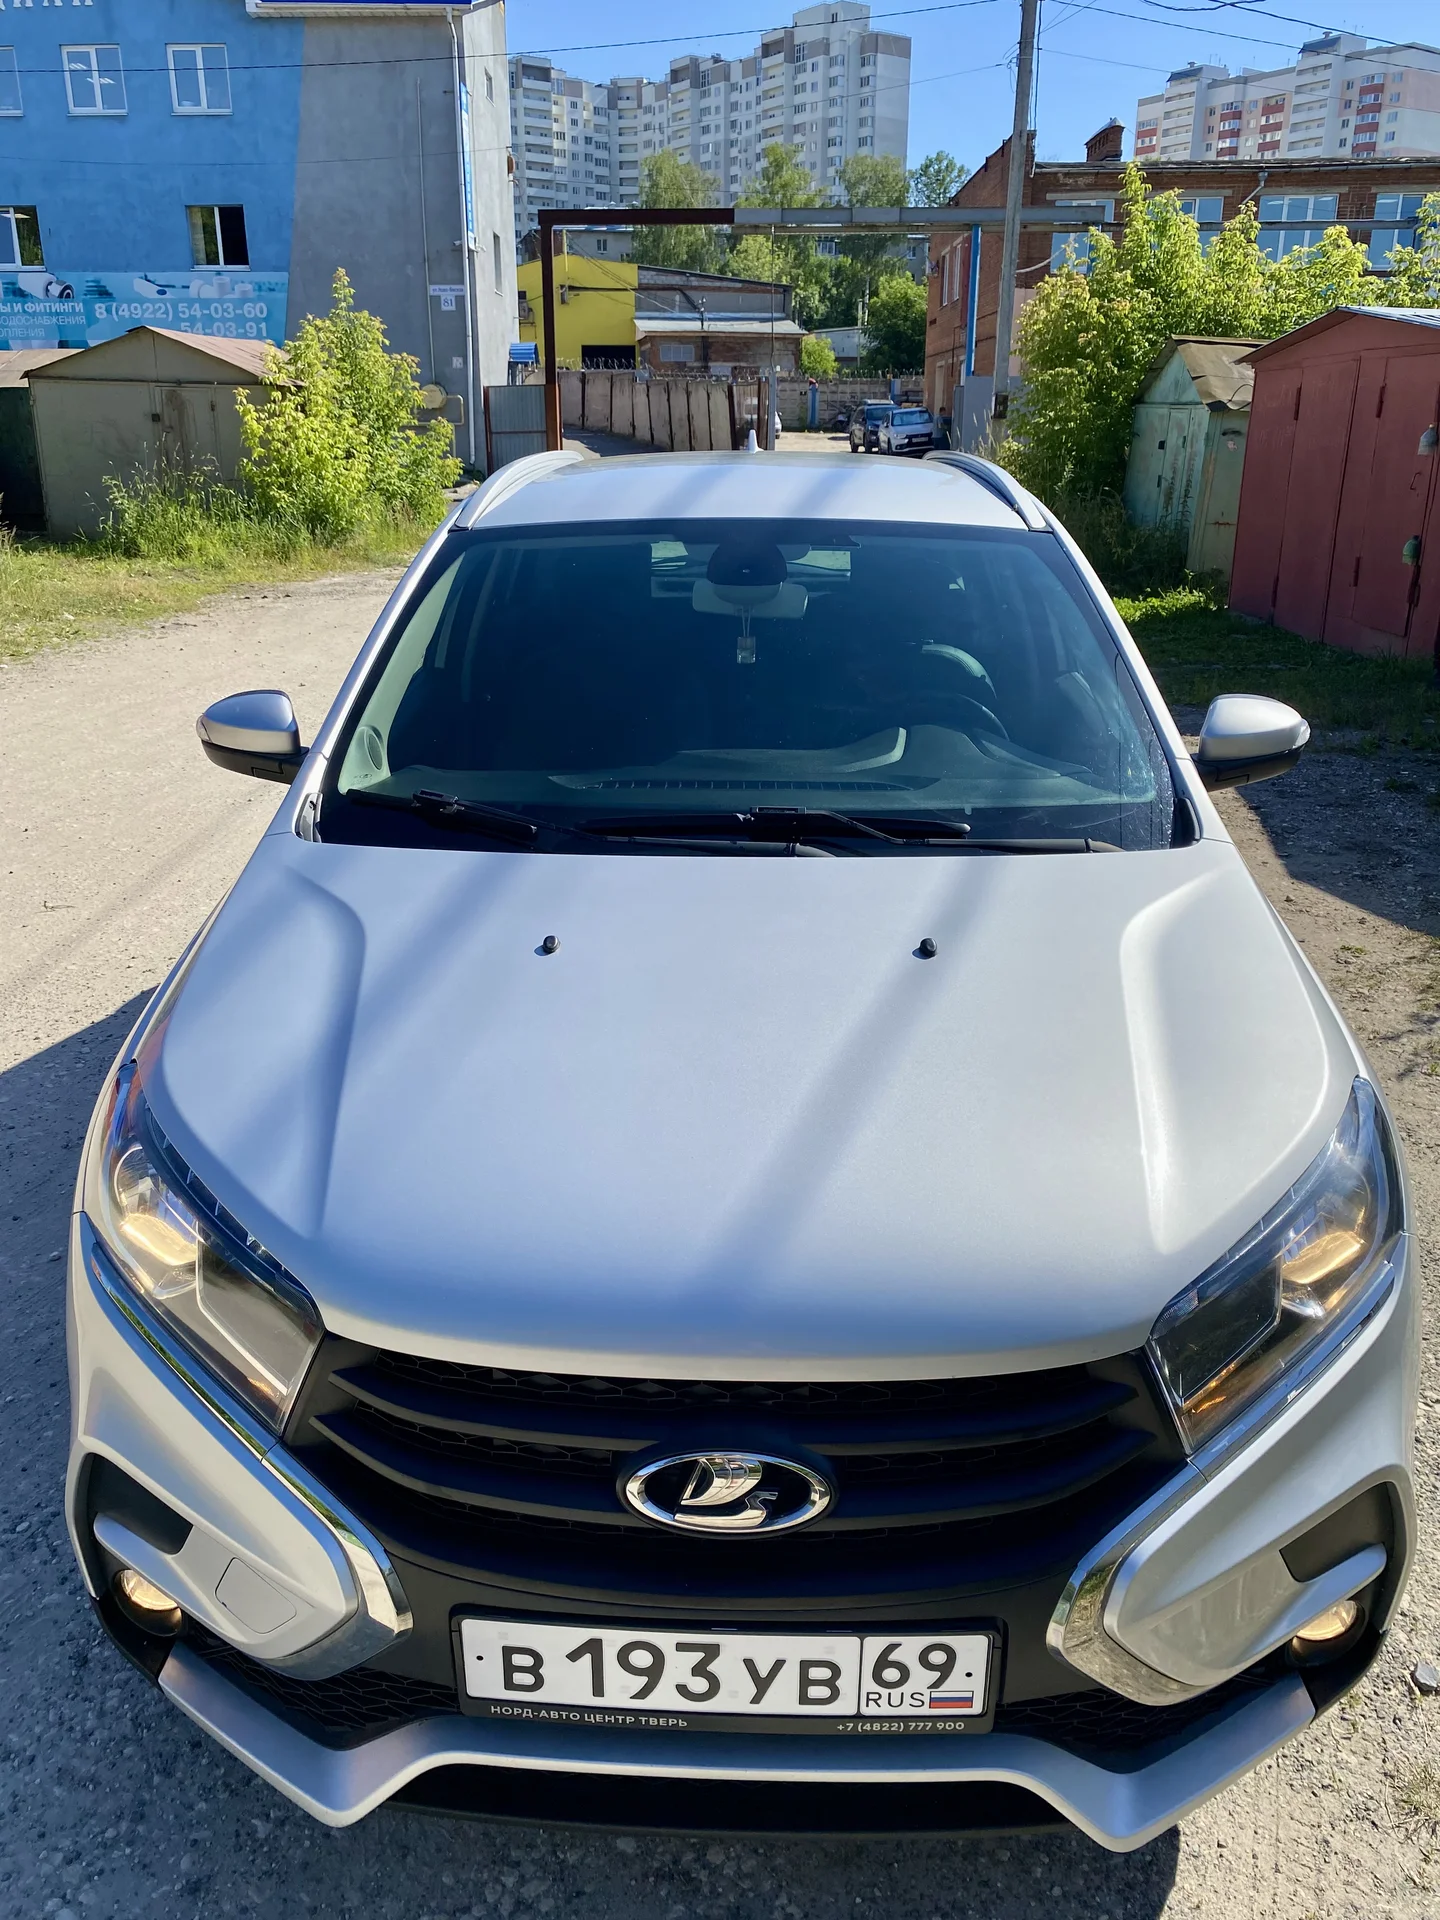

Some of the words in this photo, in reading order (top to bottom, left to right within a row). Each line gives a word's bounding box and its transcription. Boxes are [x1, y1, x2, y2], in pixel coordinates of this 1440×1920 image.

[13, 303, 23, 313] И
[24, 302, 84, 313] ФИТИНГИ
[443, 297, 453, 307] 81
[94, 303, 107, 319] 8
[111, 302, 174, 322] (4922)
[178, 302, 268, 319] 54-03-60
[0, 315, 87, 327] ОДОСНАБЖЕНИЯ
[180, 321, 268, 338] 54-03-91
[871, 1642, 958, 1690] 69
[865, 1691, 926, 1708] RUS
[490, 1704, 581, 1721] НОРД-АВТО
[584, 1713, 635, 1725] ЦЕНТР
[638, 1716, 688, 1728] ТВЕРЬ
[836, 1723, 855, 1732] +7
[857, 1721, 905, 1733] (4822)
[908, 1722, 933, 1732] 777
[936, 1721, 966, 1731] 900
